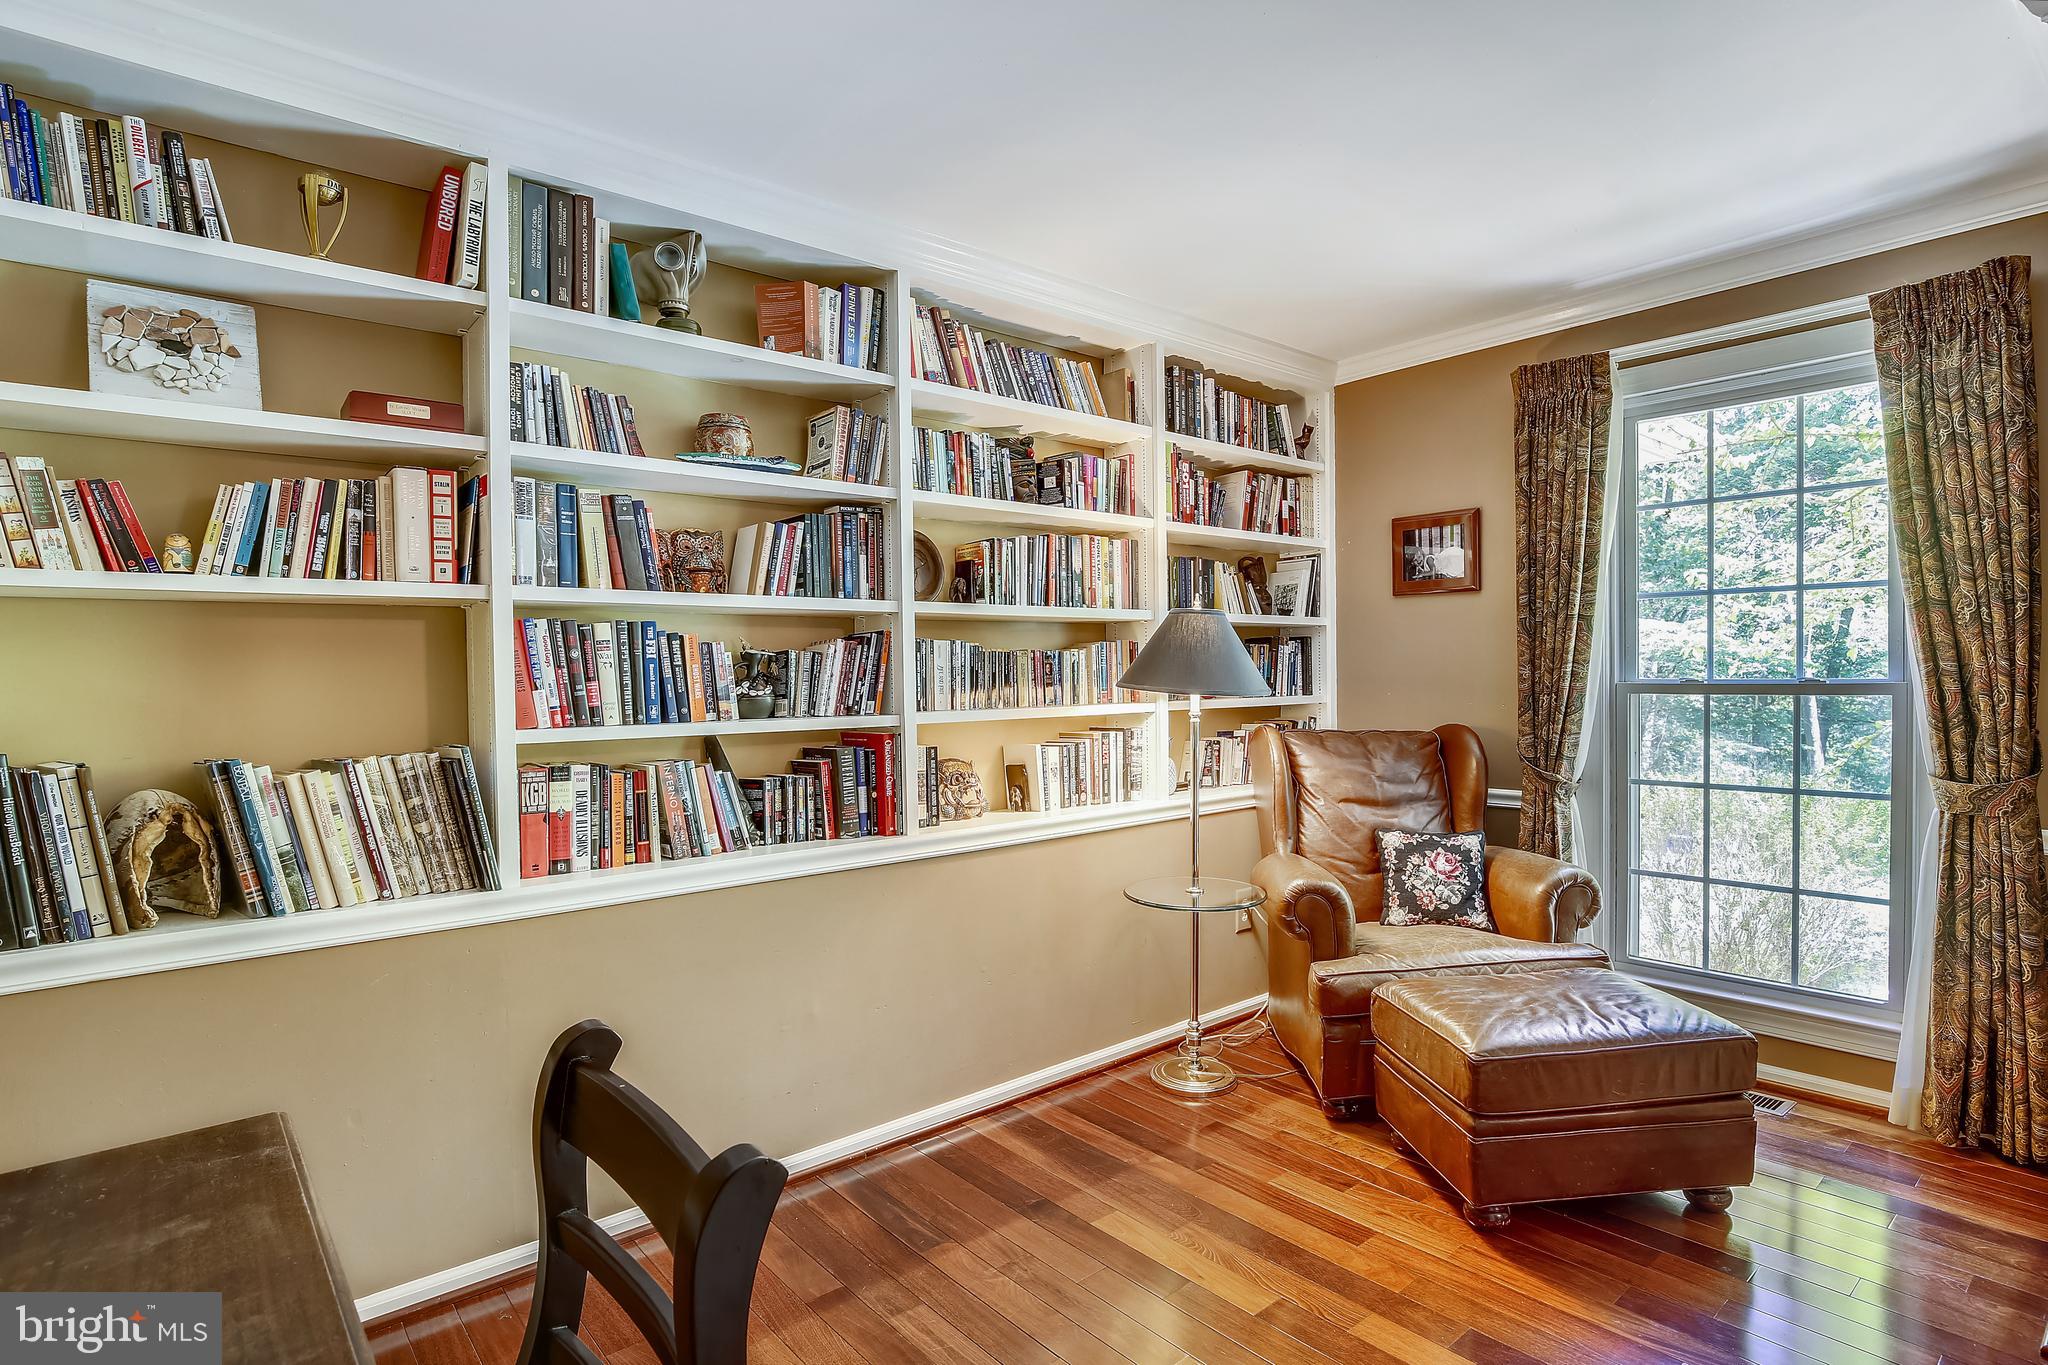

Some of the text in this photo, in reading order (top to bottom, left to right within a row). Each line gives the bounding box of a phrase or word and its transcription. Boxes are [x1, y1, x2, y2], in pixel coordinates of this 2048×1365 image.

[130, 126, 145, 158] DILBERT
[142, 203, 150, 219] ADAMS
[437, 174, 460, 232] UNBORED
[183, 208, 194, 232] FRANKEN
[465, 200, 483, 266] THE LABYRINTH
[848, 287, 856, 322] INFINITE
[274, 529, 284, 551] URALS
[312, 535, 326, 571] БЕРИЯ:
[542, 635, 552, 668] Good Guys
[620, 631, 628, 643] THE
[621, 645, 629, 659] SPY
[646, 640, 656, 659] FBI
[514, 670, 526, 693] ENEMIES
[704, 665, 712, 686] PUZZLE
[624, 687, 632, 714] TRAITOR
[233, 766, 252, 803] БЕЛГРАД
[463, 753, 476, 788] MONTANA
[663, 763, 677, 808] INFERNO
[840, 755, 855, 805] FIVE FAMILIES
[521, 782, 546, 807] KGB
[39, 812, 53, 834] ДОНА
[54, 813, 72, 866] OUR DUMB WORLD
[575, 790, 588, 858] DEADLY ILLUSIONS
[45, 837, 58, 868] ТИХОГО
